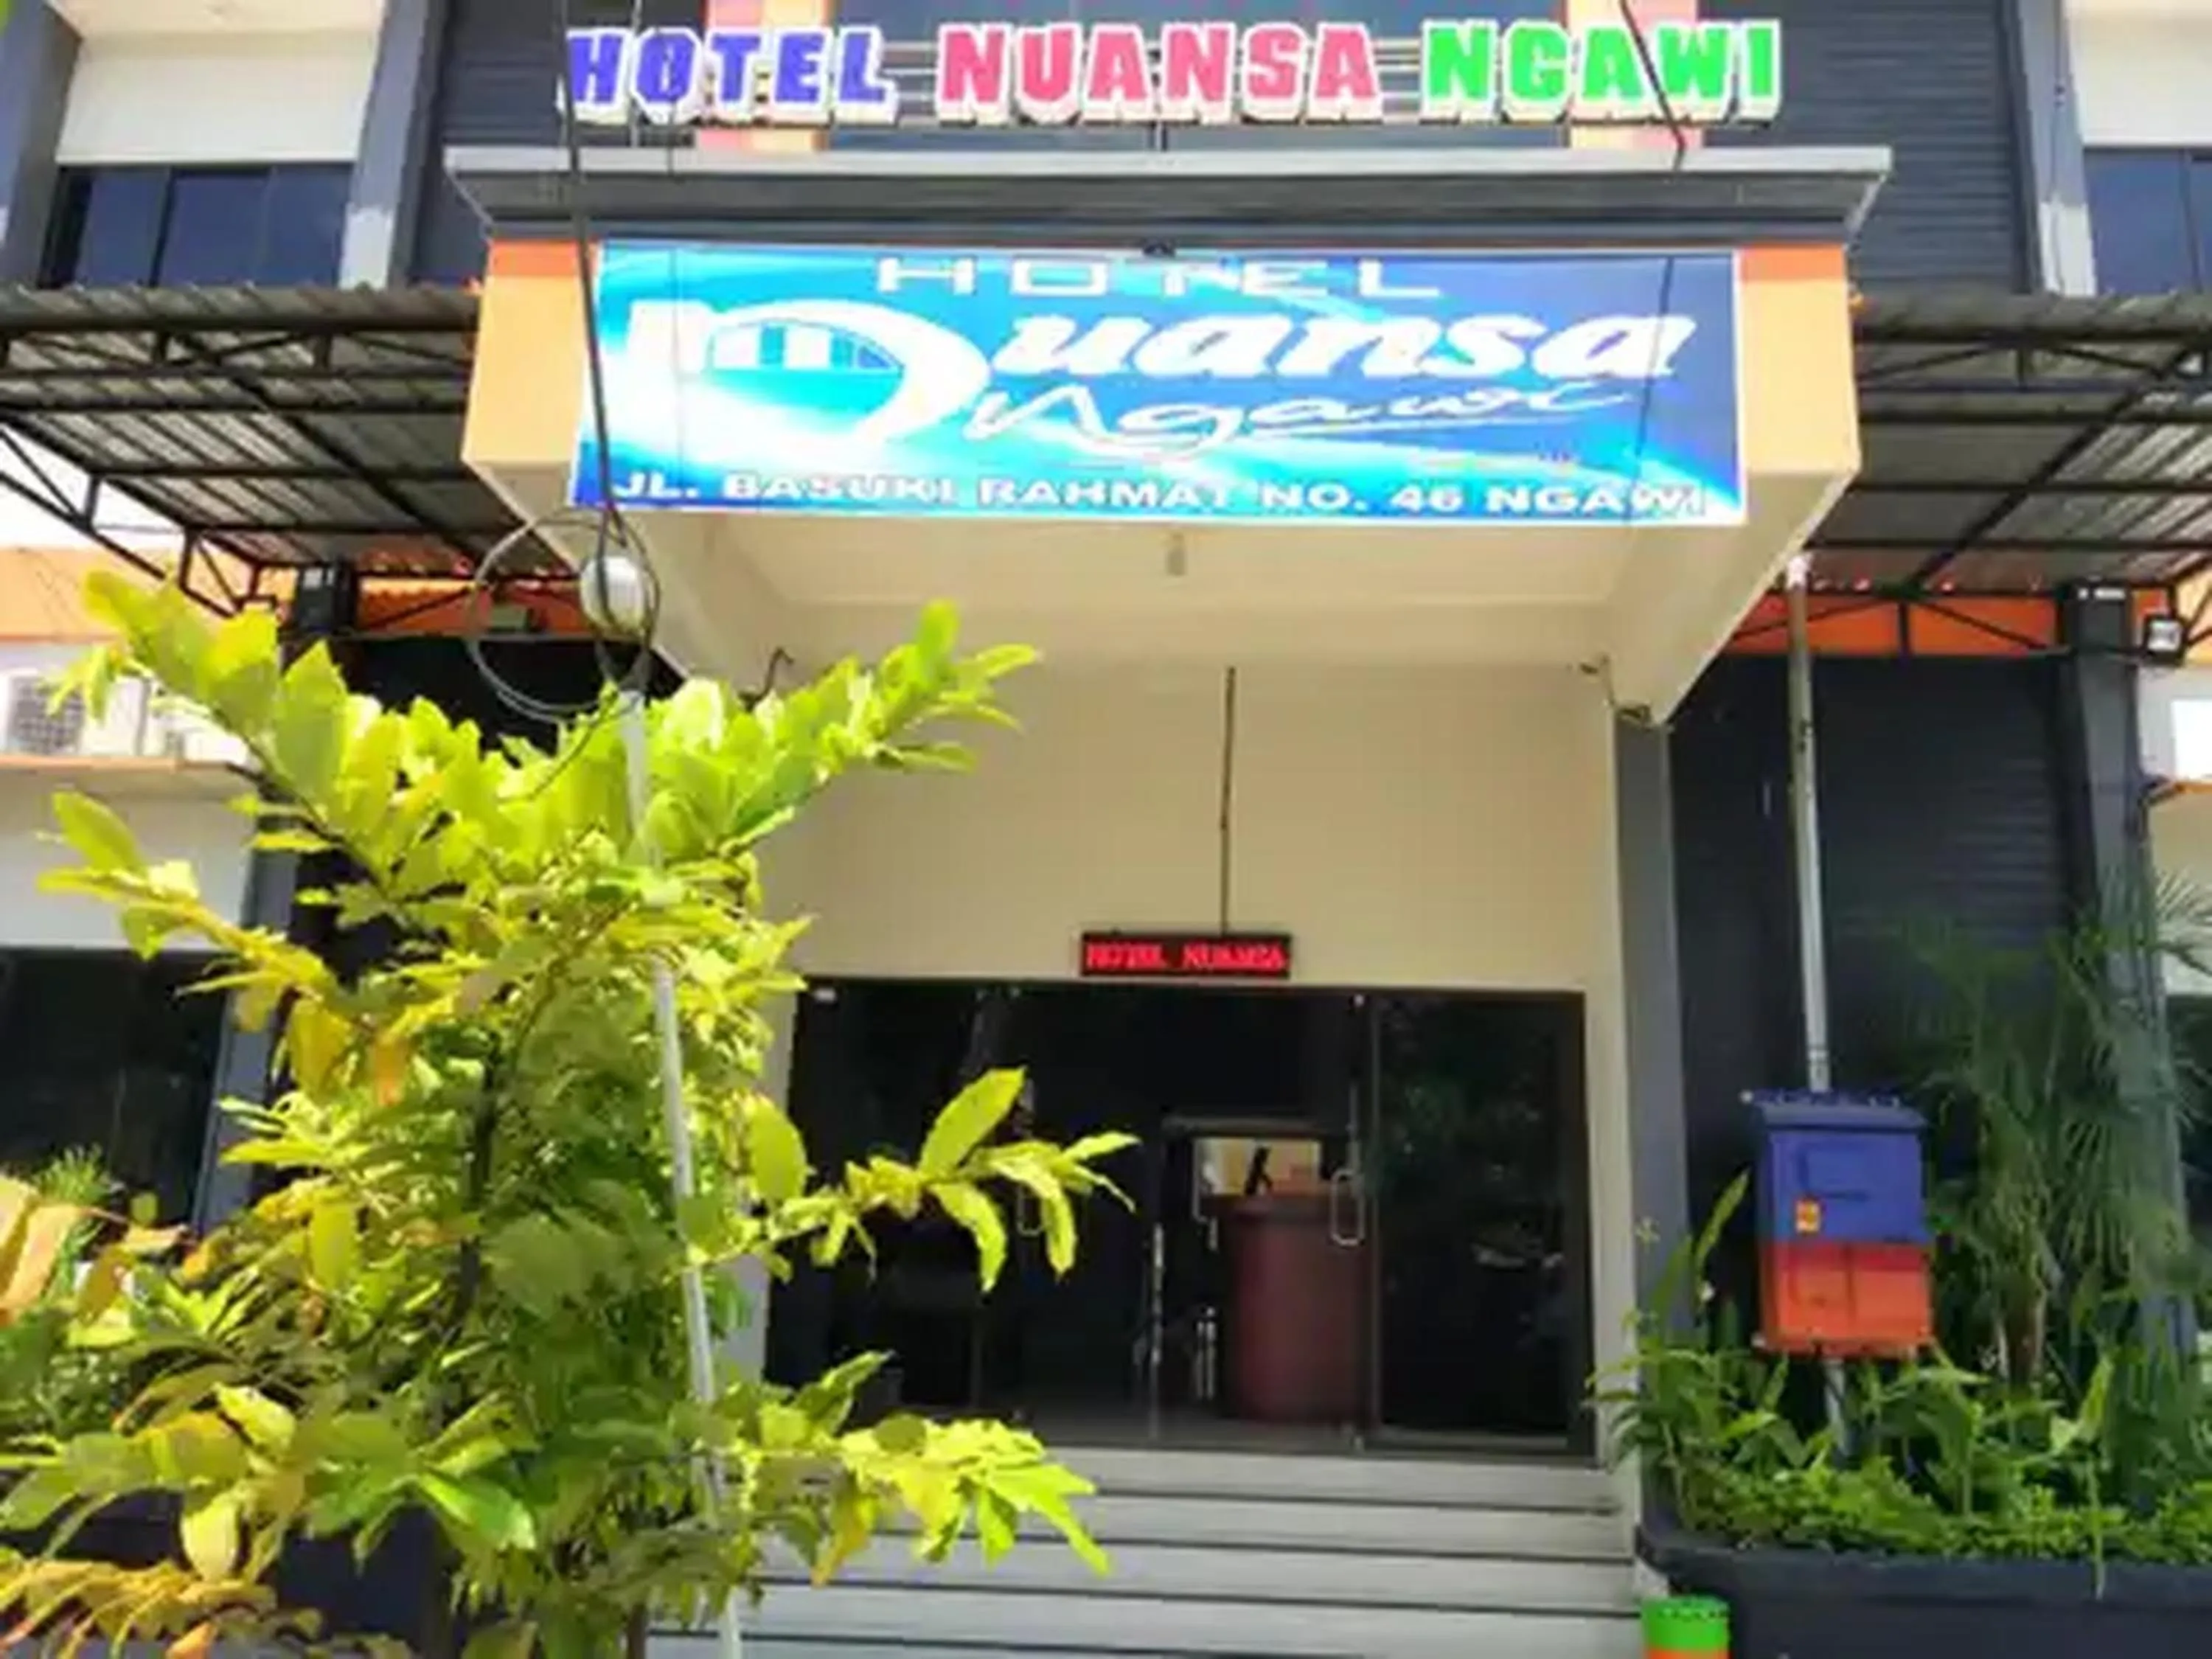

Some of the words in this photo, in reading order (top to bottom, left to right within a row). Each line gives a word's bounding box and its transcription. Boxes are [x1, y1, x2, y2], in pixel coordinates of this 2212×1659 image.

[559, 27, 897, 123] HOTEL
[935, 23, 1382, 124] NUANSA
[1420, 20, 1781, 124] NGAWI
[876, 256, 1441, 296] HOTEL
[611, 470, 700, 500] JL.
[720, 472, 961, 505] BASUKI
[976, 478, 1236, 509] RAHMAT
[1261, 482, 1368, 512] NO.
[1389, 484, 1464, 513] 46
[1484, 484, 1708, 518] NGAWI
